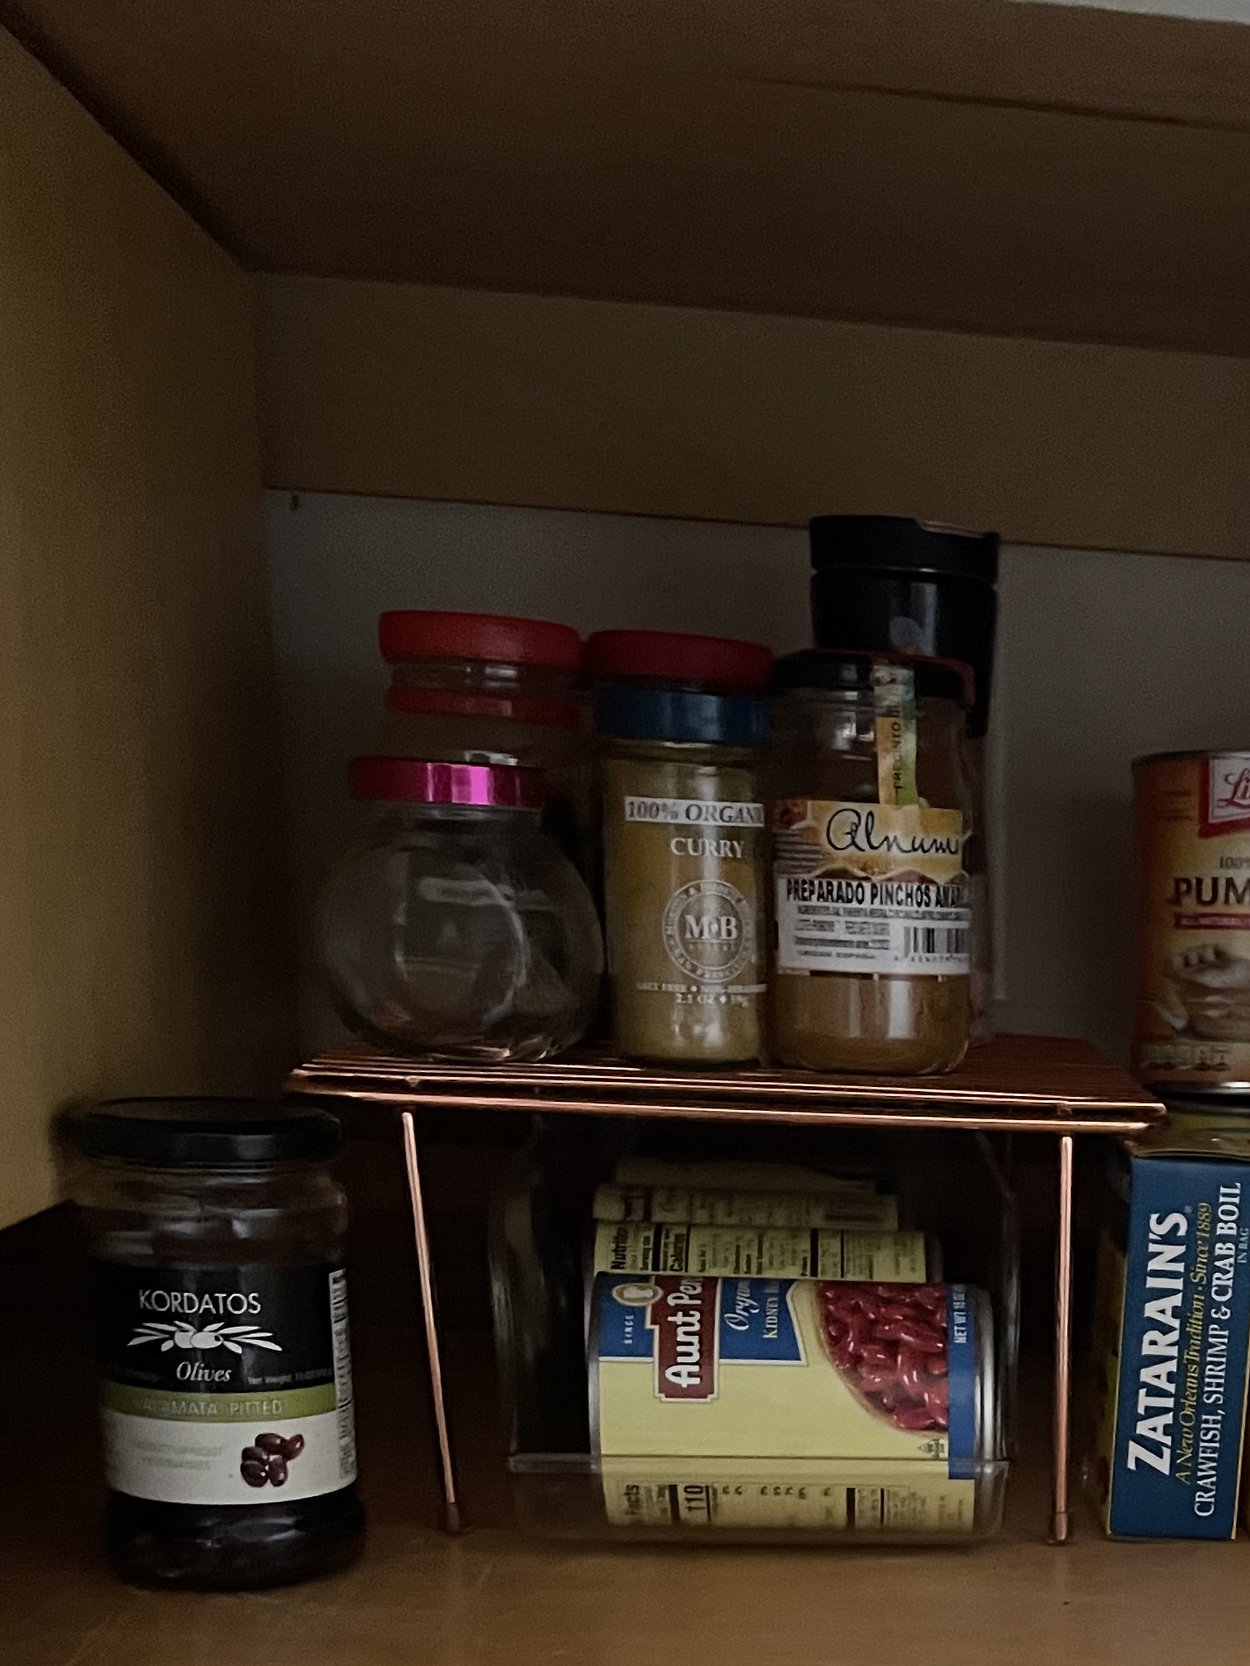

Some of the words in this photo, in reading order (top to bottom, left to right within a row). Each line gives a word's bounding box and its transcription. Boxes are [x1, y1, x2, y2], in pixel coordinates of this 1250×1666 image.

[627, 801, 678, 820] 100%
[670, 838, 744, 858] CURRY
[787, 879, 865, 905] PREPARADO
[871, 883, 932, 907] PINCHOS
[1197, 1202, 1213, 1239] 1889
[1216, 1182, 1242, 1235] BOIL
[1239, 1227, 1250, 1251] BAG
[1190, 1241, 1209, 1284] Since
[1211, 1242, 1236, 1301] CRAB
[1238, 1253, 1249, 1264] IN
[138, 1288, 262, 1315] KORDATOS
[1211, 1307, 1232, 1320] &
[763, 1298, 780, 1340] KIDNEY
[953, 1309, 967, 1324] WT
[1185, 1294, 1206, 1364] Tradition
[665, 1309, 701, 1388] Aunt
[953, 1326, 968, 1345] NET
[1127, 1212, 1189, 1477] ZATARAIN'S
[175, 1361, 233, 1383] Olives
[1203, 1324, 1230, 1408] SHRIMP
[229, 1399, 284, 1416] PITTED
[1179, 1365, 1198, 1426] Orleans
[1178, 1428, 1194, 1466] New
[1175, 1470, 1190, 1485] A
[1194, 1410, 1225, 1518] CRAWFISH,
[684, 1485, 704, 1512] 110
